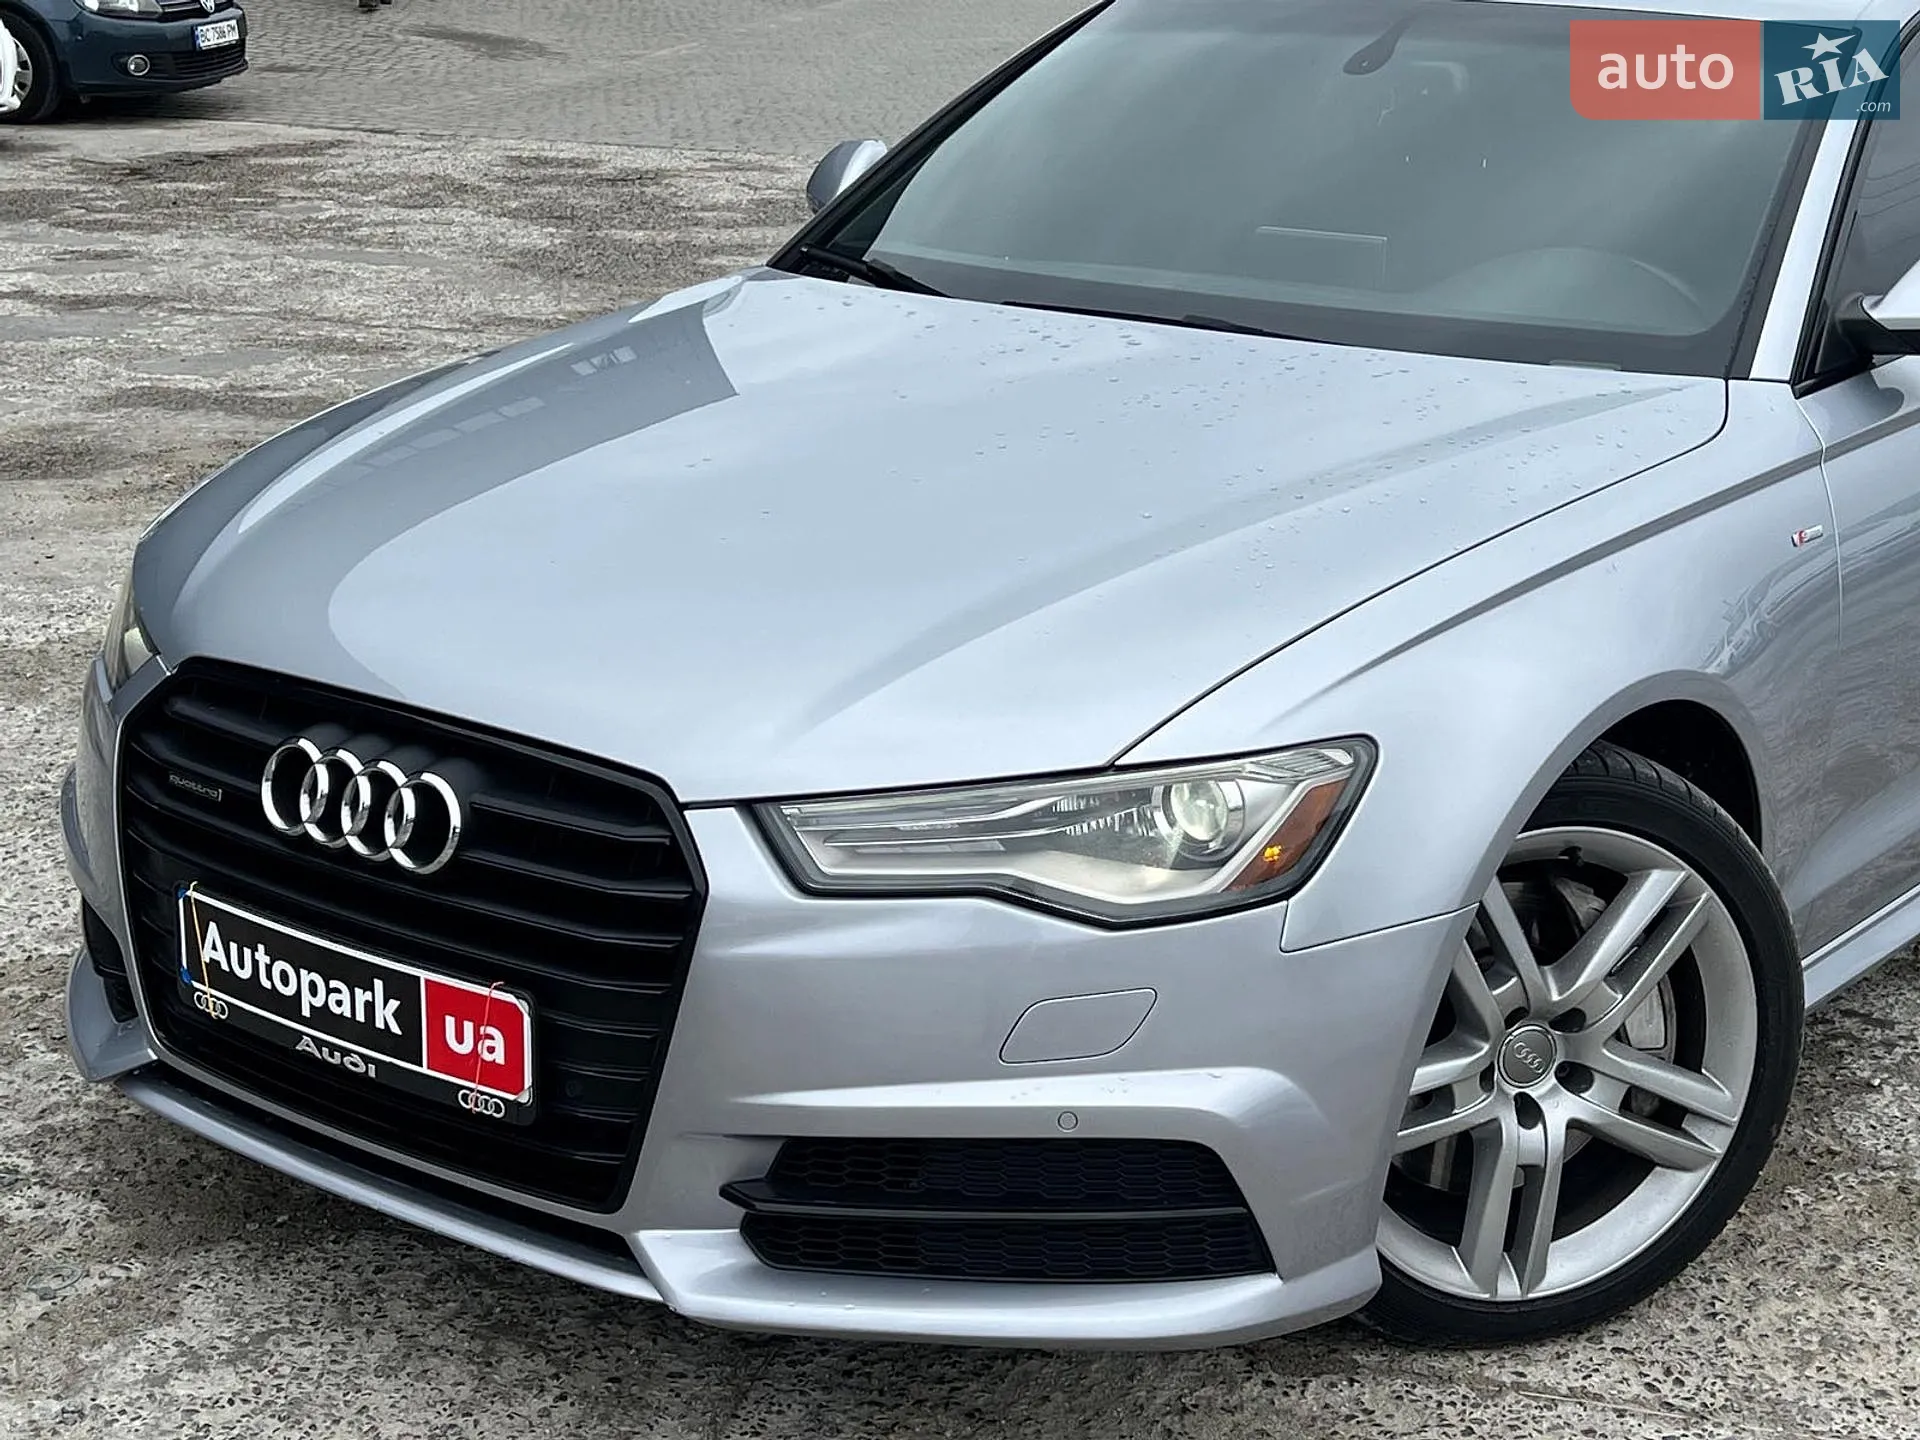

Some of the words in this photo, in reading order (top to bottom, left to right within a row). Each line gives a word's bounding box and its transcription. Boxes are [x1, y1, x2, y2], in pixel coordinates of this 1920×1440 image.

[169, 774, 218, 799] quattro
[203, 921, 403, 1035] Autopark
[444, 1014, 506, 1066] ua
